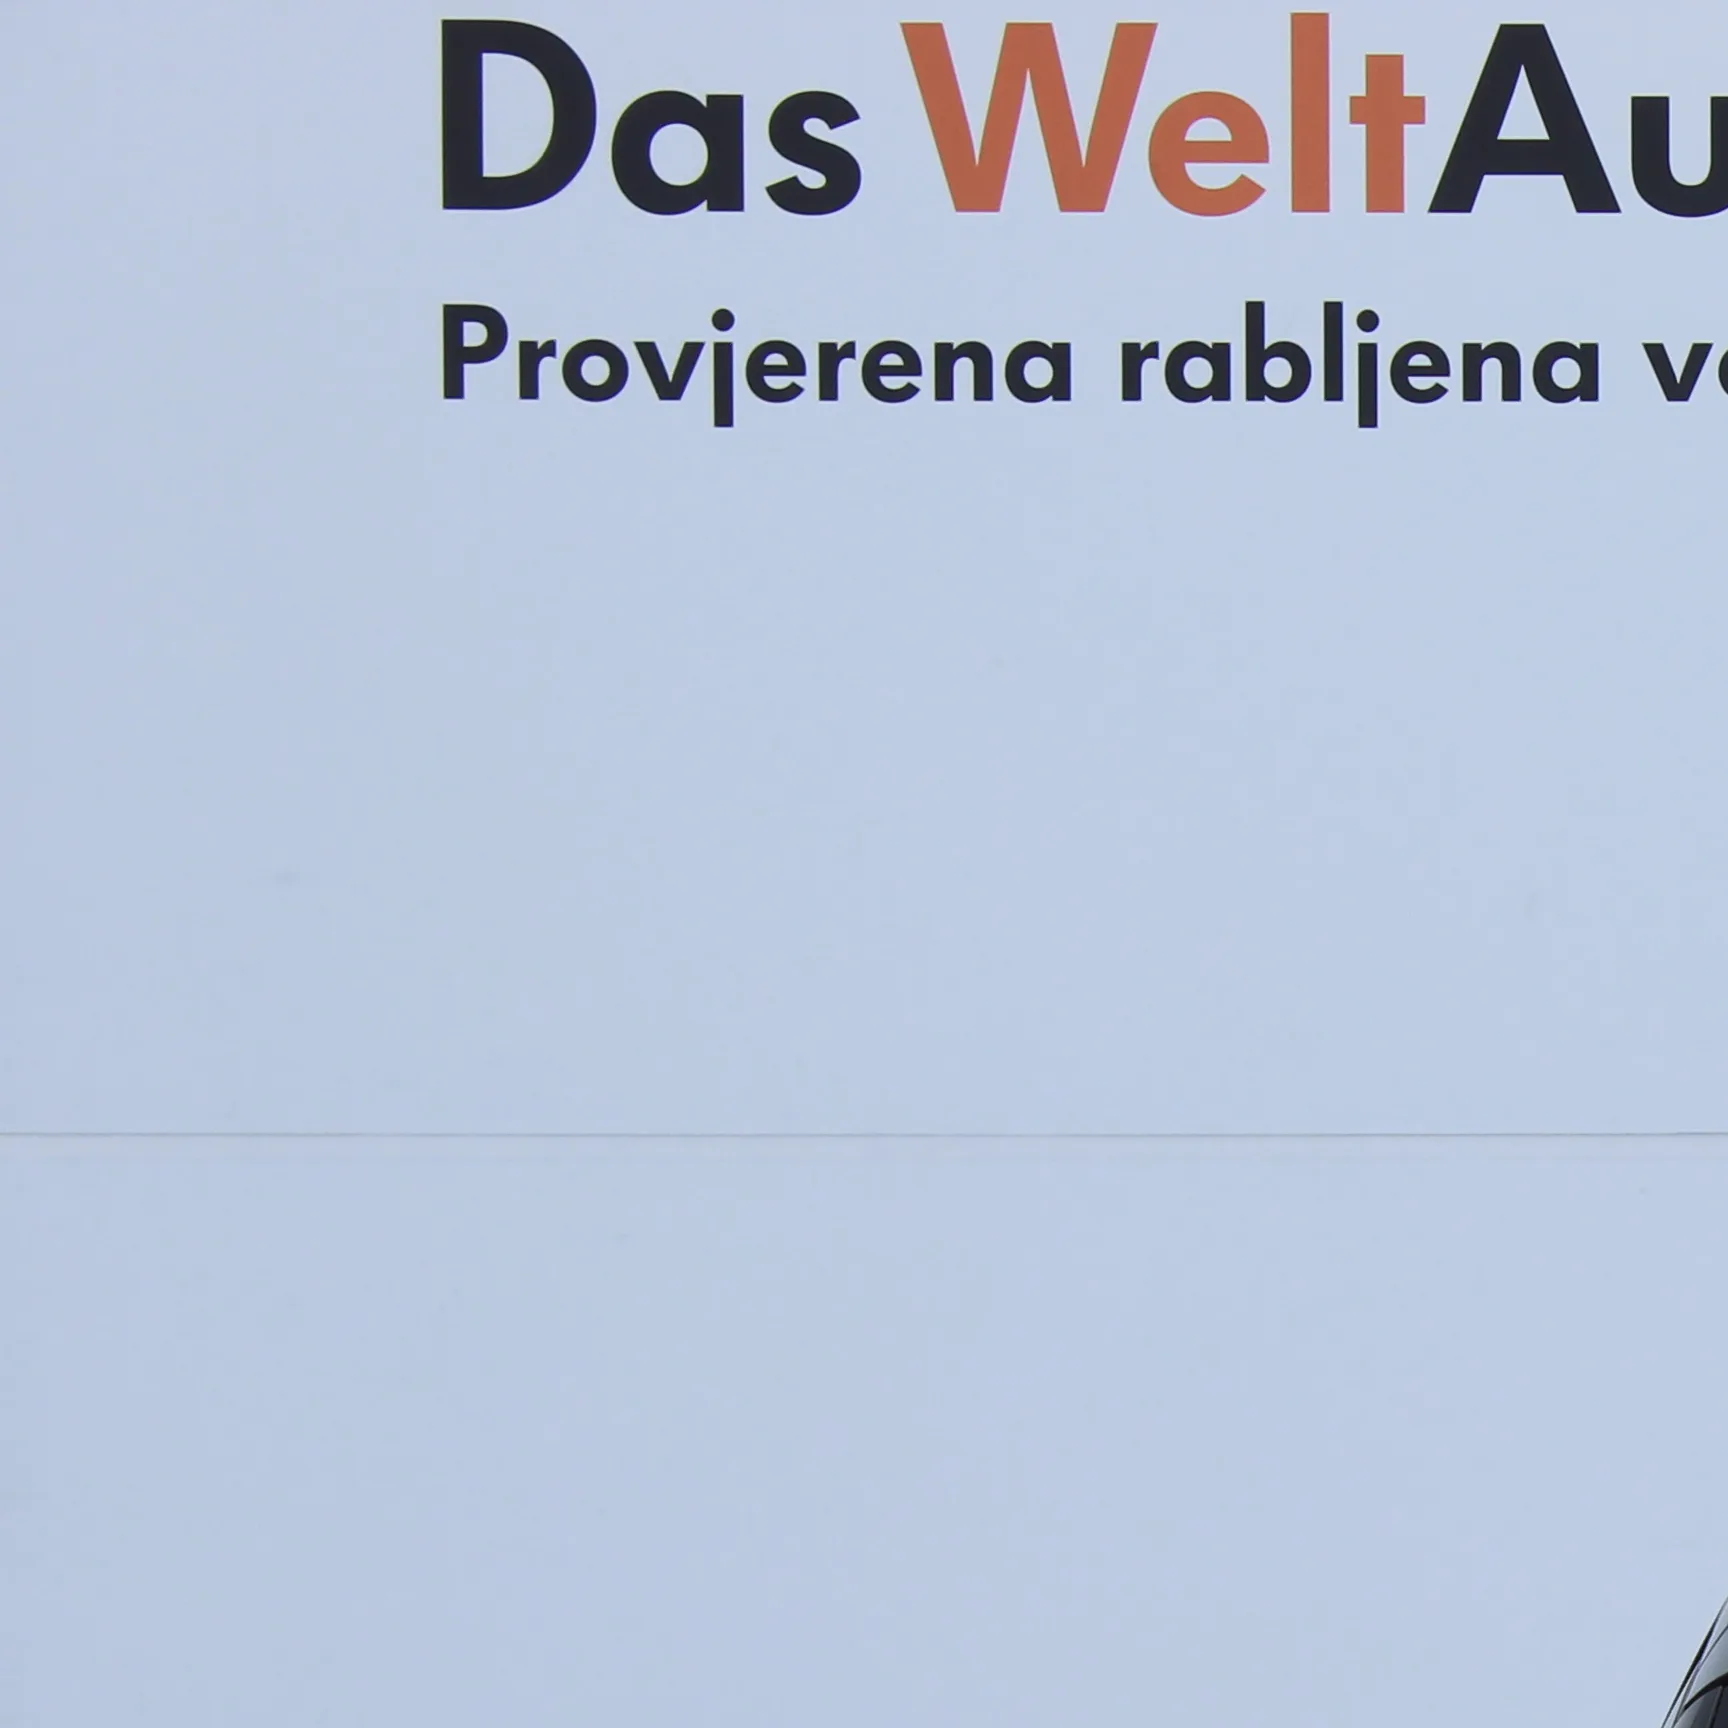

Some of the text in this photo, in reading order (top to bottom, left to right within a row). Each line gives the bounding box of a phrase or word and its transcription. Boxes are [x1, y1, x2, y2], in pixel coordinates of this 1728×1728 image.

[441, 17, 862, 216] Das
[442, 303, 1072, 428] Provjerena
[1121, 300, 1599, 429] rabljena
